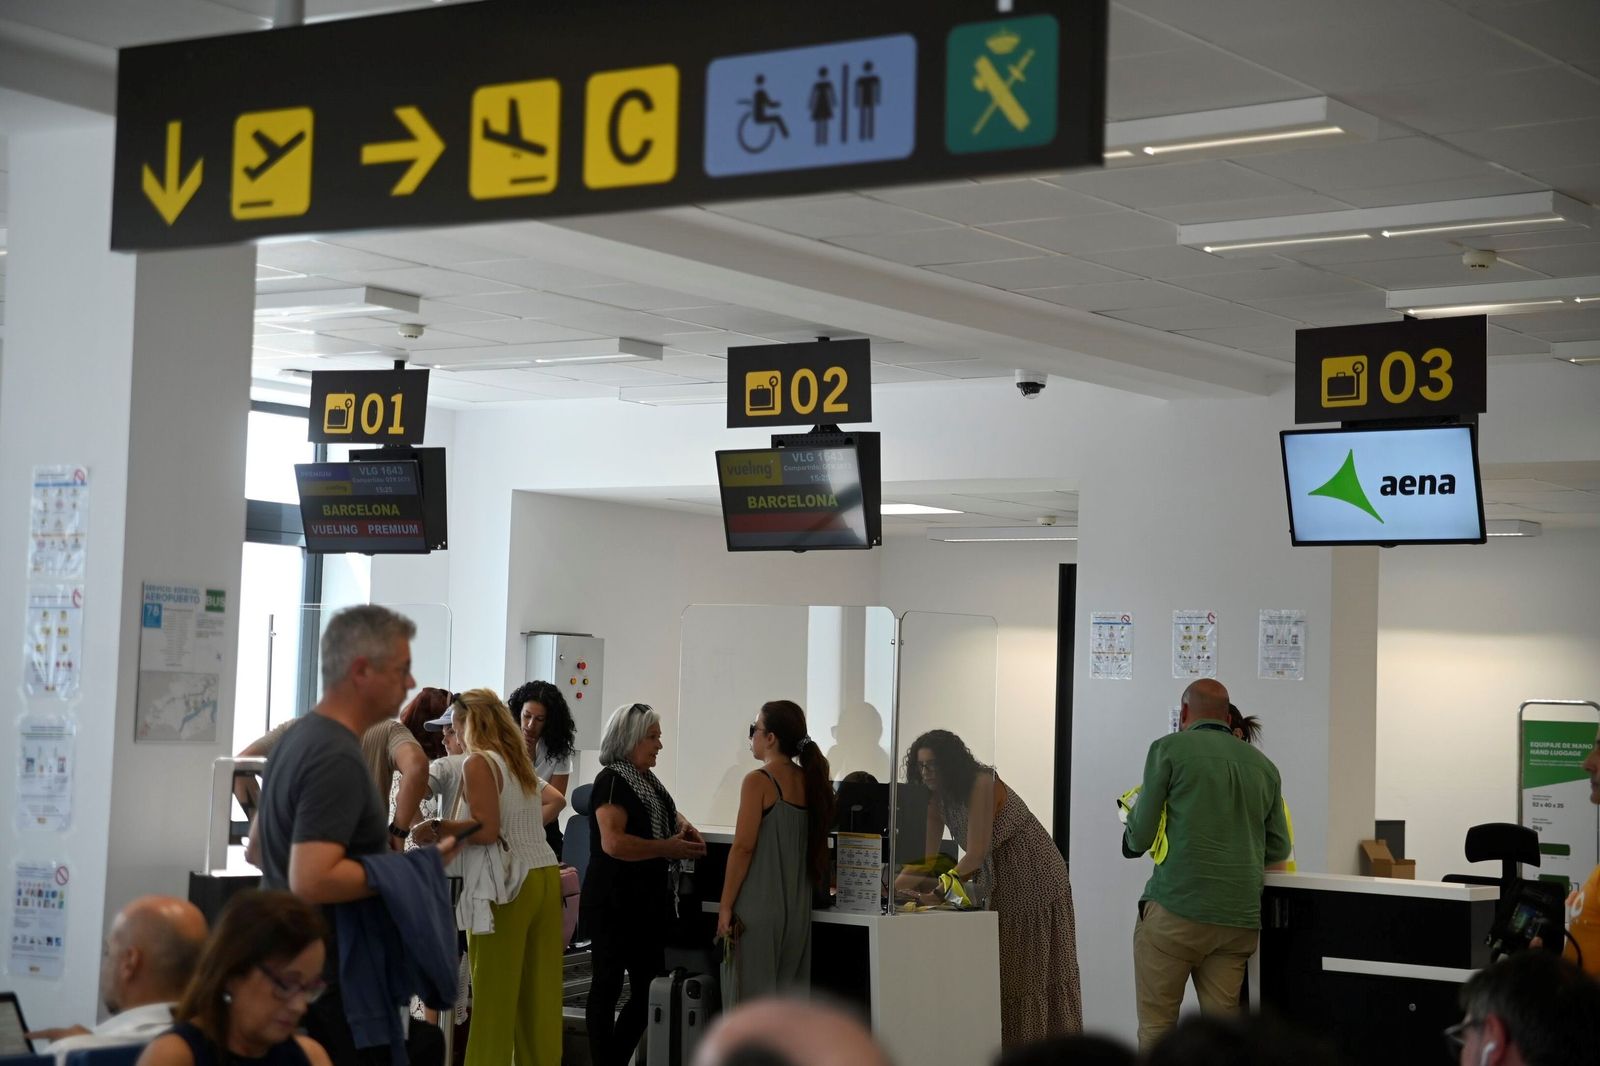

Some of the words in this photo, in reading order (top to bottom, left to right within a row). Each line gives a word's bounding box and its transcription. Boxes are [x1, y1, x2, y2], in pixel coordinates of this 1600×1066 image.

[607, 88, 654, 166] C
[1379, 347, 1454, 404] 03
[790, 366, 849, 415] 02
[360, 392, 404, 435] 01
[792, 452, 814, 463] VLG
[359, 466, 379, 475] VLG
[381, 465, 404, 475] 1643
[726, 460, 773, 477] vueling
[1379, 473, 1456, 496] aena
[747, 494, 838, 508] BARCELONA
[322, 504, 400, 517] BARCELONA
[311, 523, 359, 535] VUELING
[367, 523, 419, 535] PREMIUM
[145, 593, 201, 604] AEROPUERTO
[206, 596, 226, 608] BUS
[1550, 749, 1581, 757] LUGGAGE
